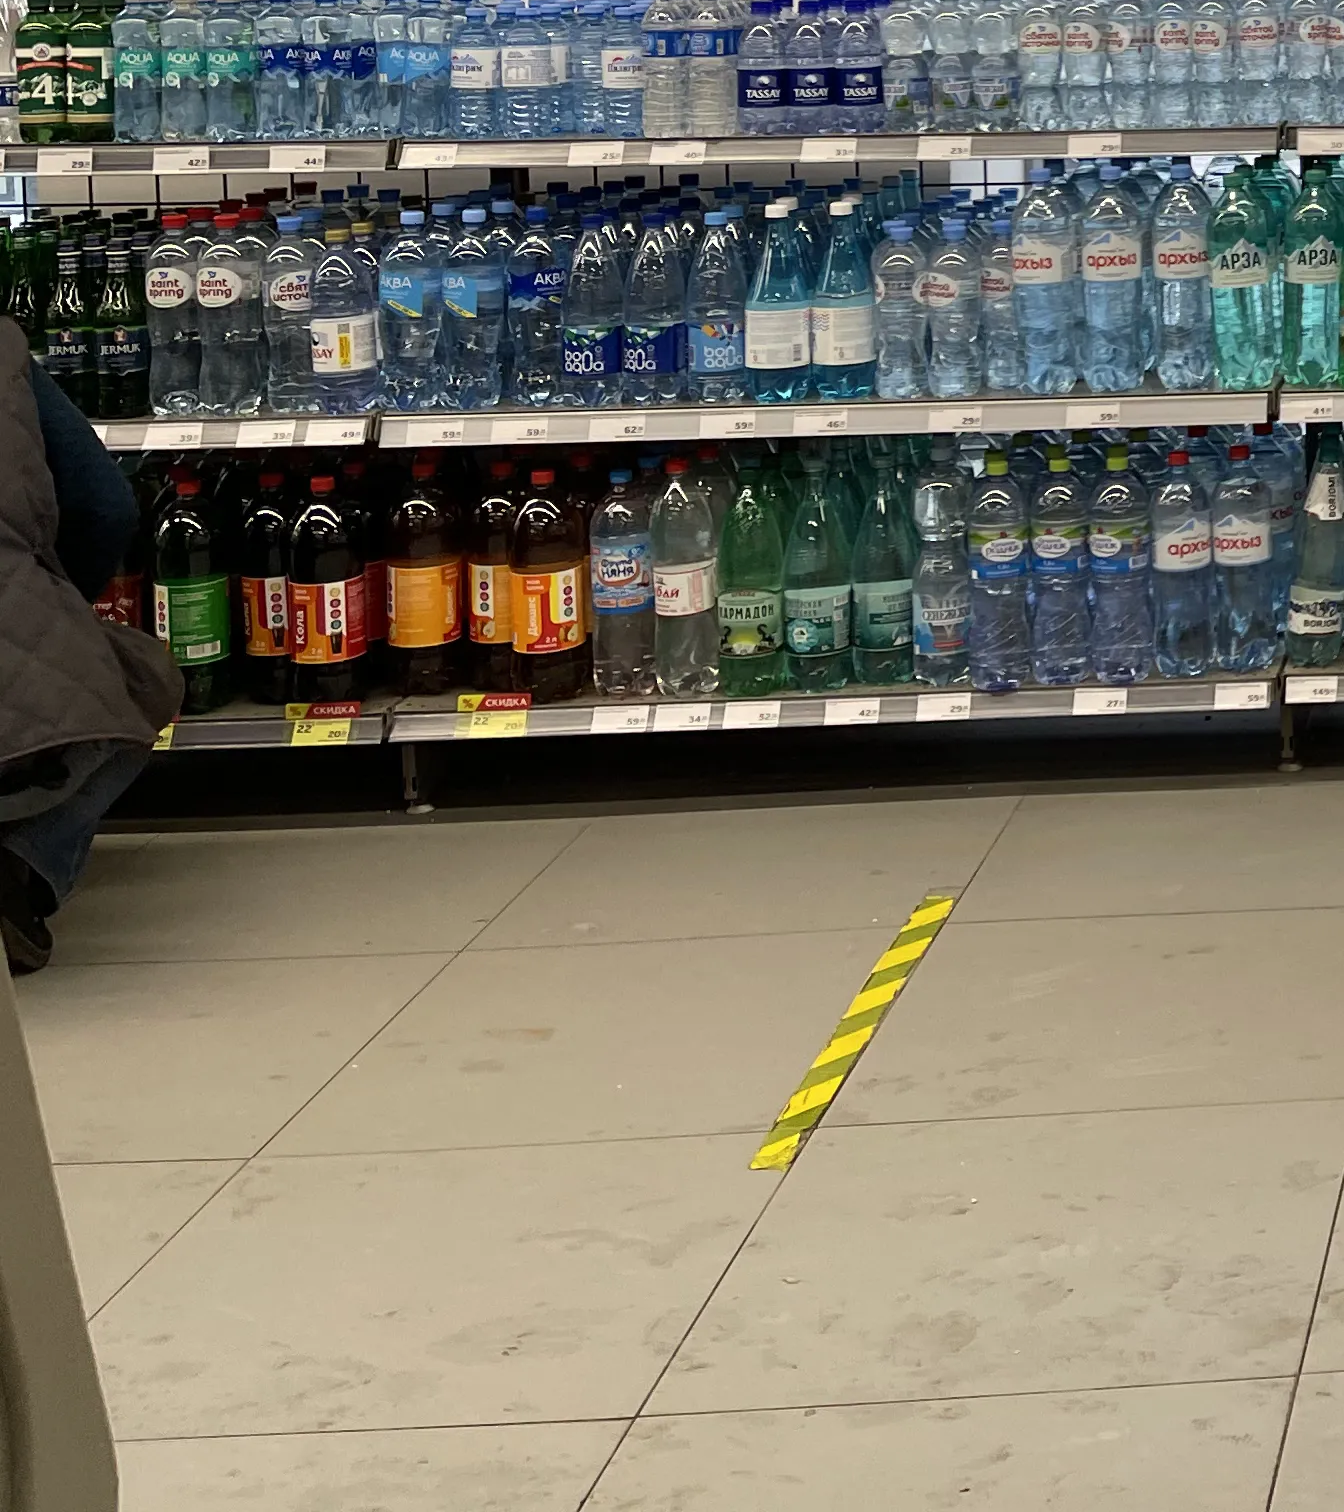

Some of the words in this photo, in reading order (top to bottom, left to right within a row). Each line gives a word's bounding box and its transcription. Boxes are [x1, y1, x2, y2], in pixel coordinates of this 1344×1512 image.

[120, 52, 154, 64] AQUA
[167, 51, 200, 64] AQUA
[208, 52, 239, 64] AQUA
[407, 51, 440, 64] AQUA
[746, 89, 781, 100] TASSAY
[843, 86, 878, 100] TASSAY
[1087, 251, 1138, 268] архыз
[1158, 250, 1208, 268] архыз
[1219, 253, 1263, 271] АРЗА
[1297, 249, 1339, 268] АРЗА
[151, 278, 180, 289] saint
[200, 278, 228, 288] saint
[279, 282, 309, 293] свят
[443, 276, 465, 289] КВА
[49, 344, 88, 356] JERMUK
[100, 343, 141, 356] JERMUK
[312, 347, 334, 359] SSAY
[1168, 537, 1211, 556] архы
[601, 564, 635, 577] НЯНЯ
[295, 609, 306, 645] Кола
[485, 698, 527, 707] СКИДКА
[314, 705, 355, 716] СКИДКА
